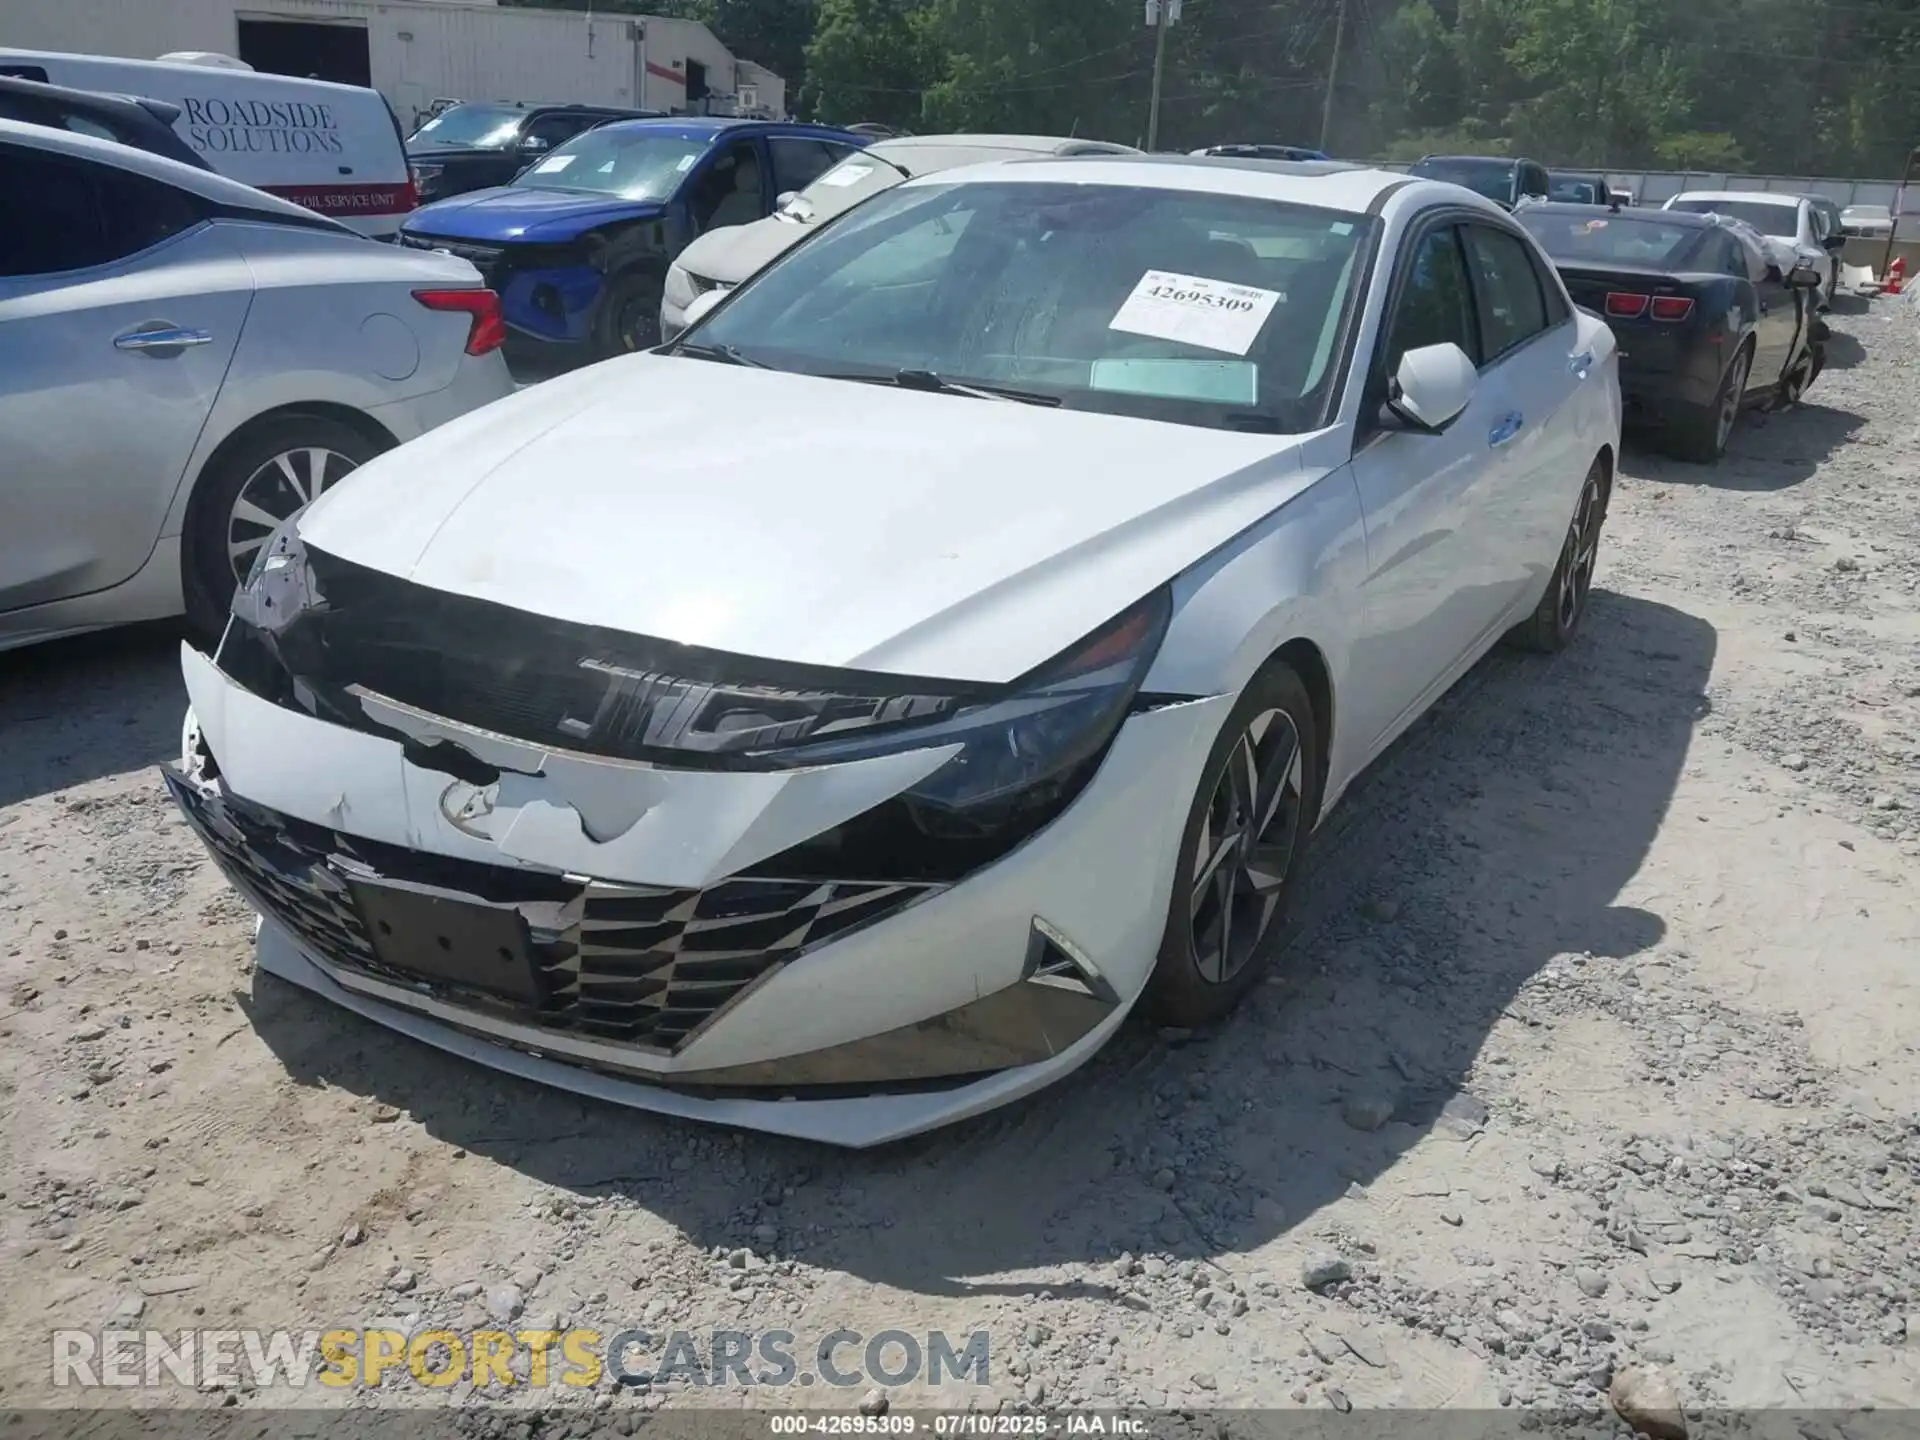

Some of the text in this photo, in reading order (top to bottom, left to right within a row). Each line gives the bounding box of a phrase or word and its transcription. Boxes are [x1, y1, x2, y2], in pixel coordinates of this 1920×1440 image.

[184, 98, 337, 129] ROADSIDE
[190, 127, 343, 153] SOLUTIONS
[303, 195, 323, 208] OIL
[324, 193, 370, 208] SERVICE
[370, 193, 395, 206] UNIT
[1148, 285, 1253, 312] 42695309
